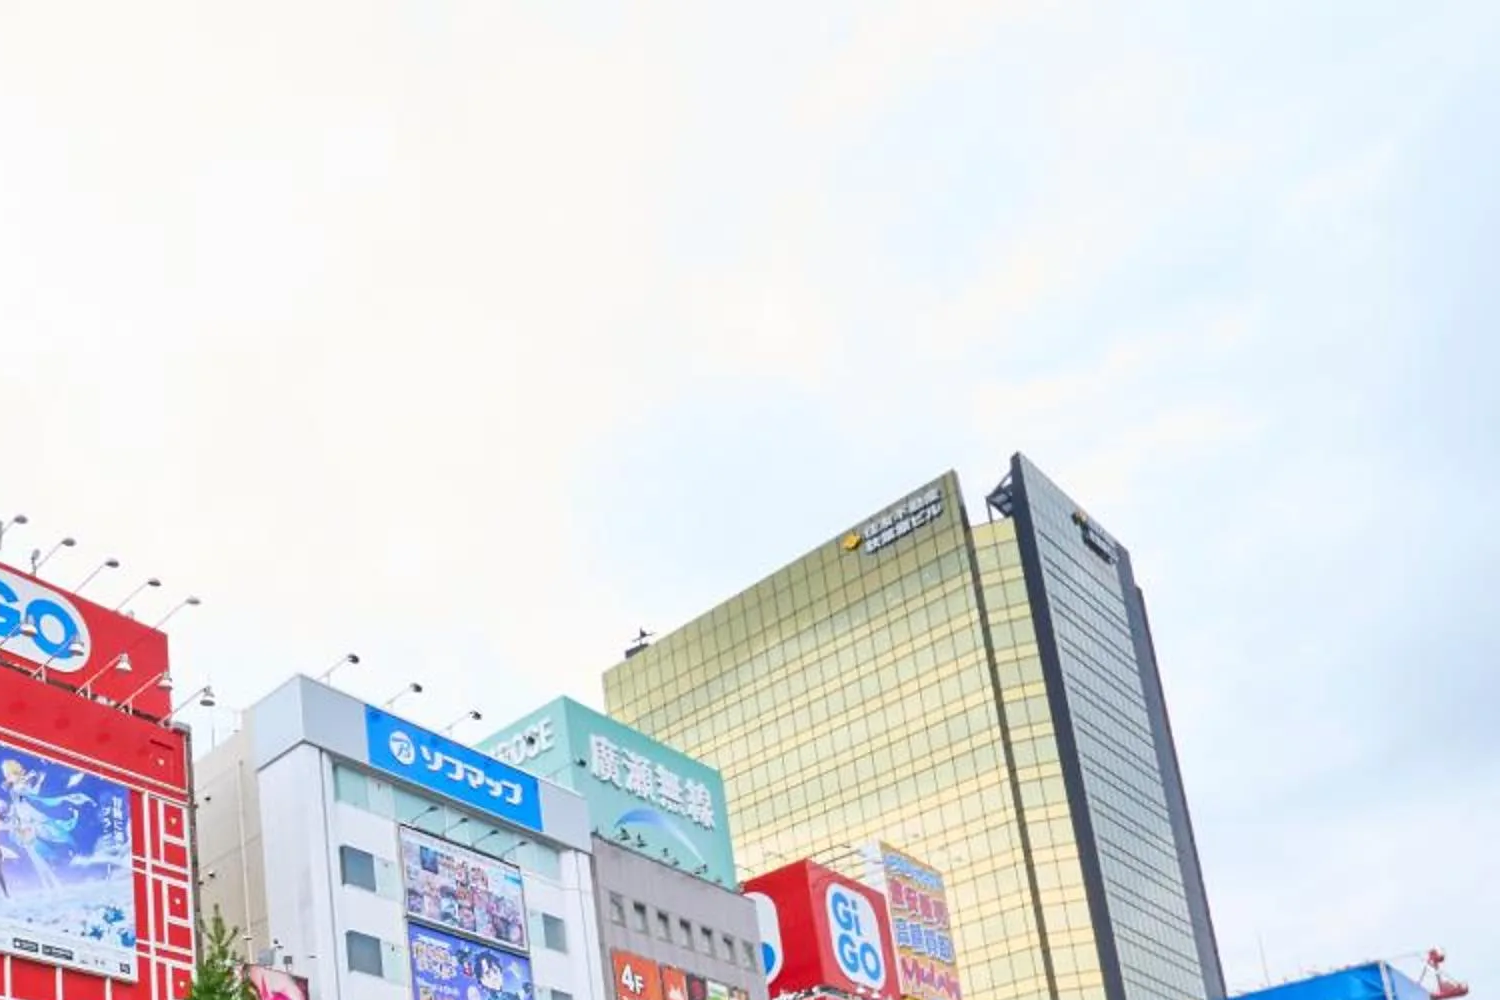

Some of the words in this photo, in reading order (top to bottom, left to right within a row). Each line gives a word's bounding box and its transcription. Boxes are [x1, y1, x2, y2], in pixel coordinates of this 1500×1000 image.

[419, 744, 523, 806] ソフマップ
[621, 963, 644, 994] 4F
